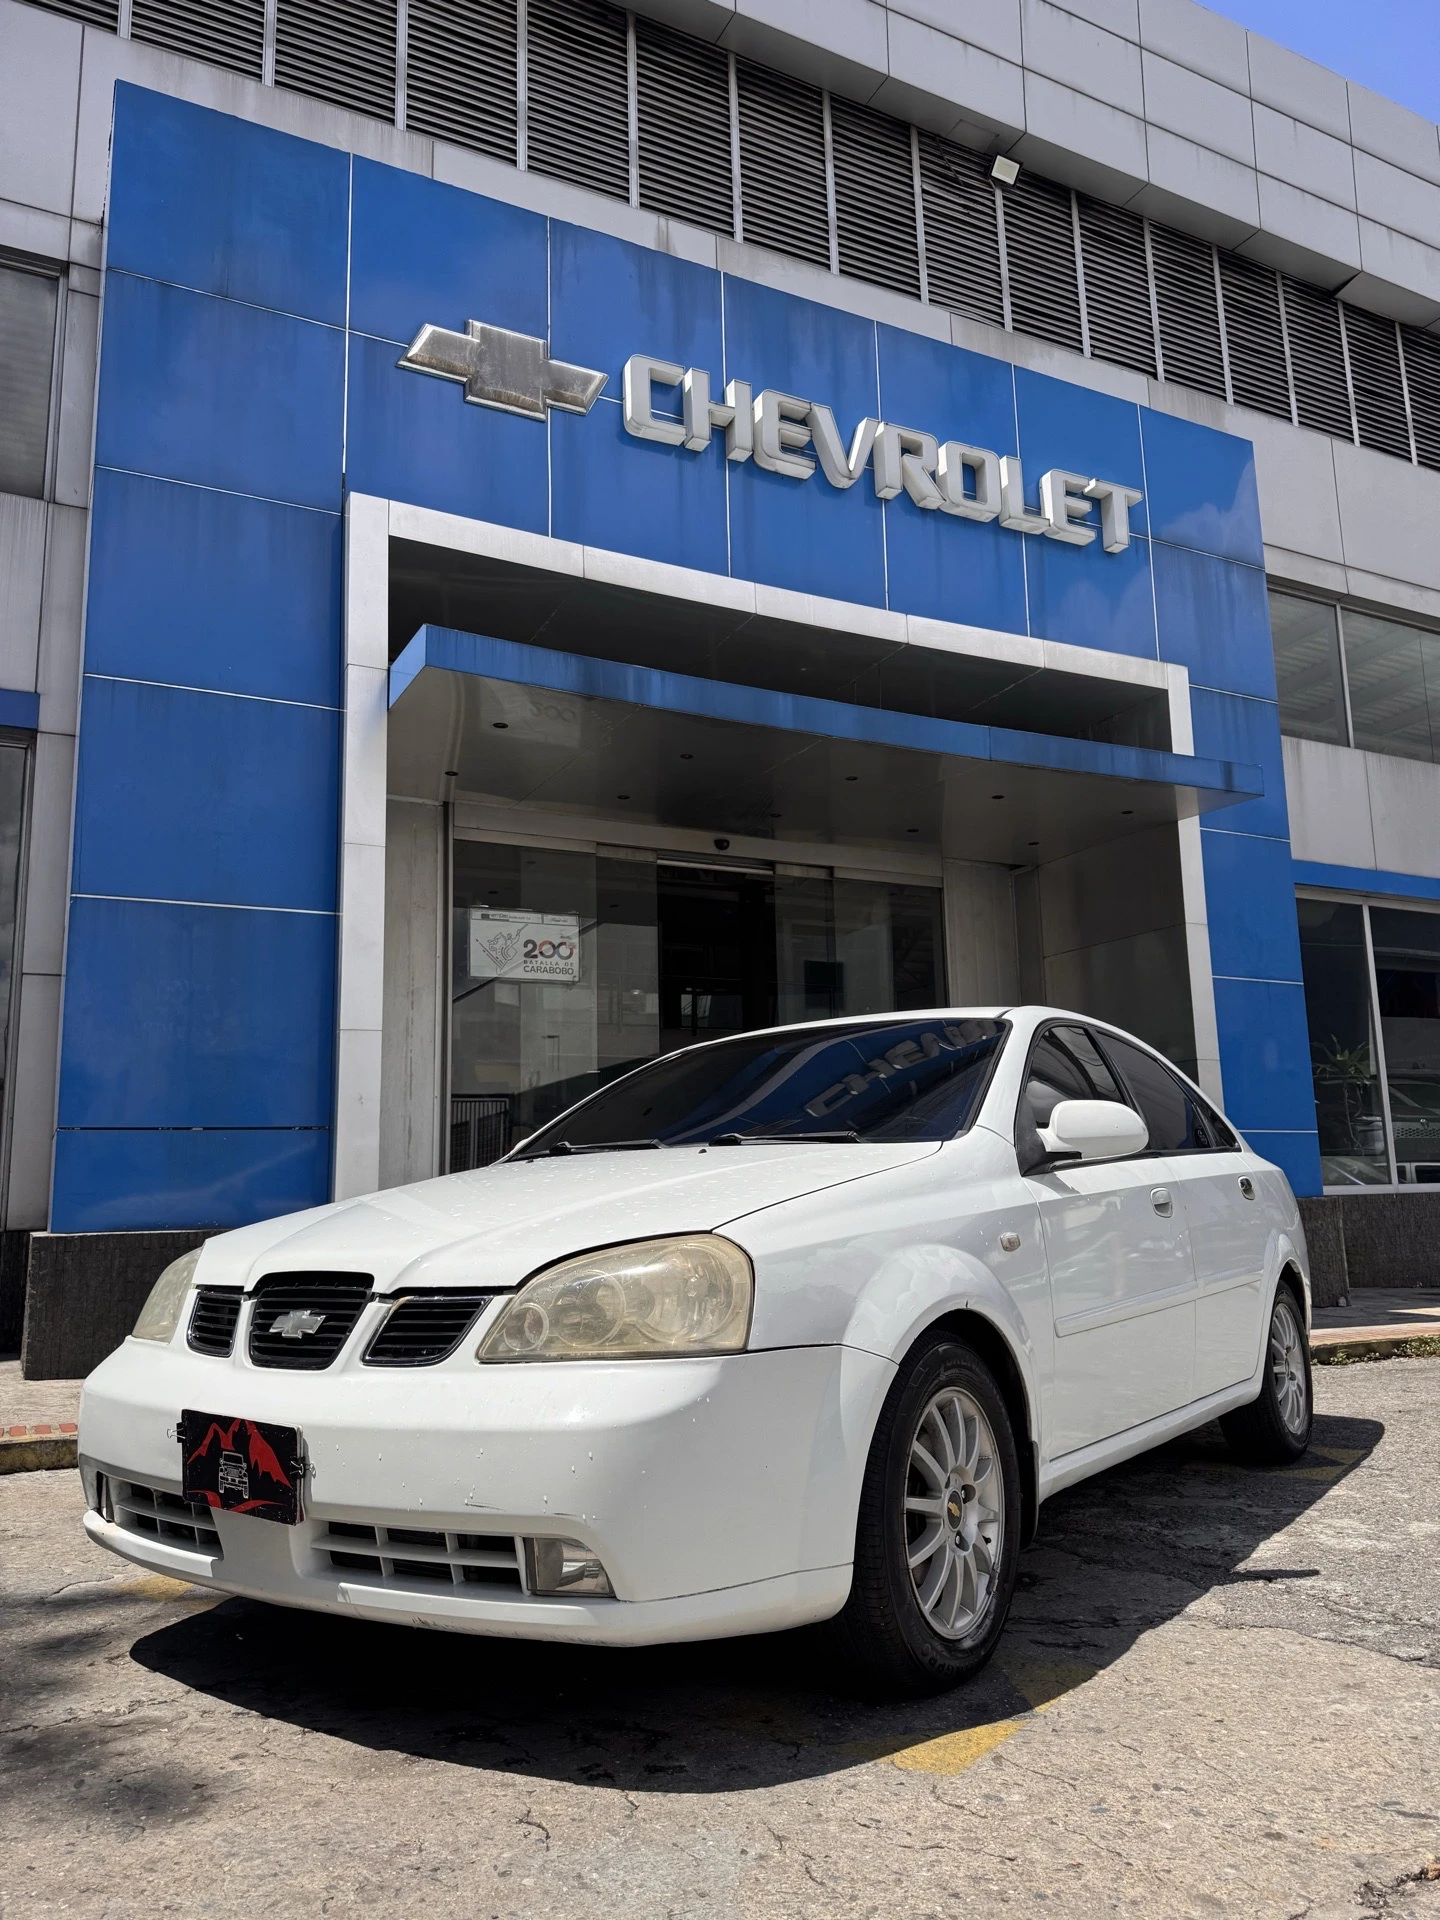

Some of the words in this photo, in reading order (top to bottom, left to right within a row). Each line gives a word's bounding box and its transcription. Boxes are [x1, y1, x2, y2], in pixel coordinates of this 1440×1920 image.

[622, 353, 1143, 554] CHEVROLET
[523, 939, 575, 960] 200
[523, 965, 575, 975] CARABOBO
